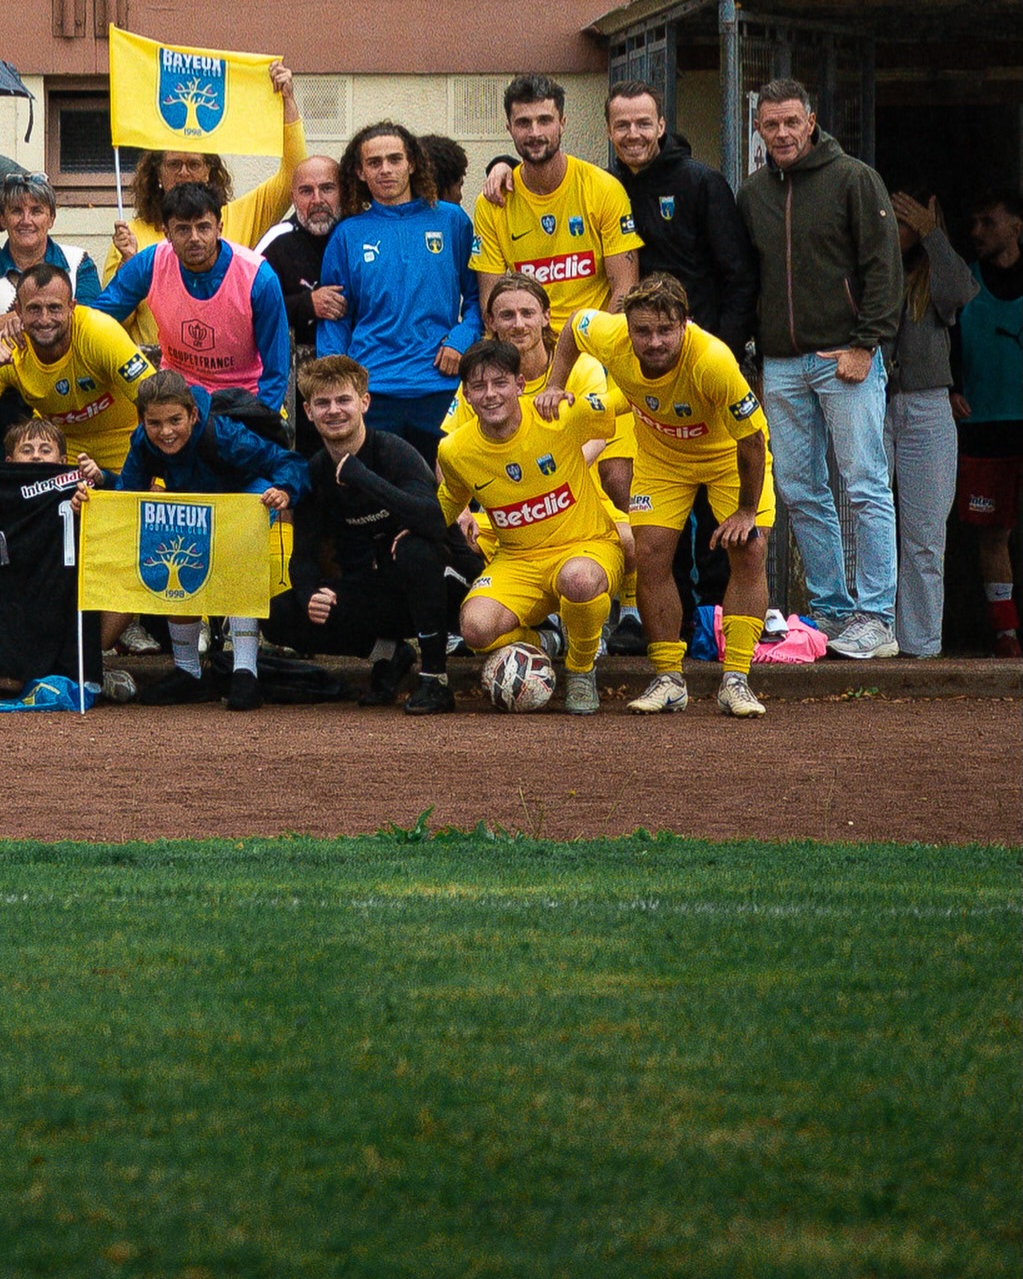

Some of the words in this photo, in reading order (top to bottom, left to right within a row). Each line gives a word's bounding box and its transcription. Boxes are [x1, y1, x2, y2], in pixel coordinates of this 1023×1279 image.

[162, 48, 222, 71] BAYEUX
[144, 503, 208, 528] BAYEUX
[492, 491, 571, 528] Betclic
[58, 500, 75, 566] 1
[144, 522, 184, 534] FOOTBALL
[187, 526, 208, 536] CLUB
[165, 589, 186, 599] 1998
